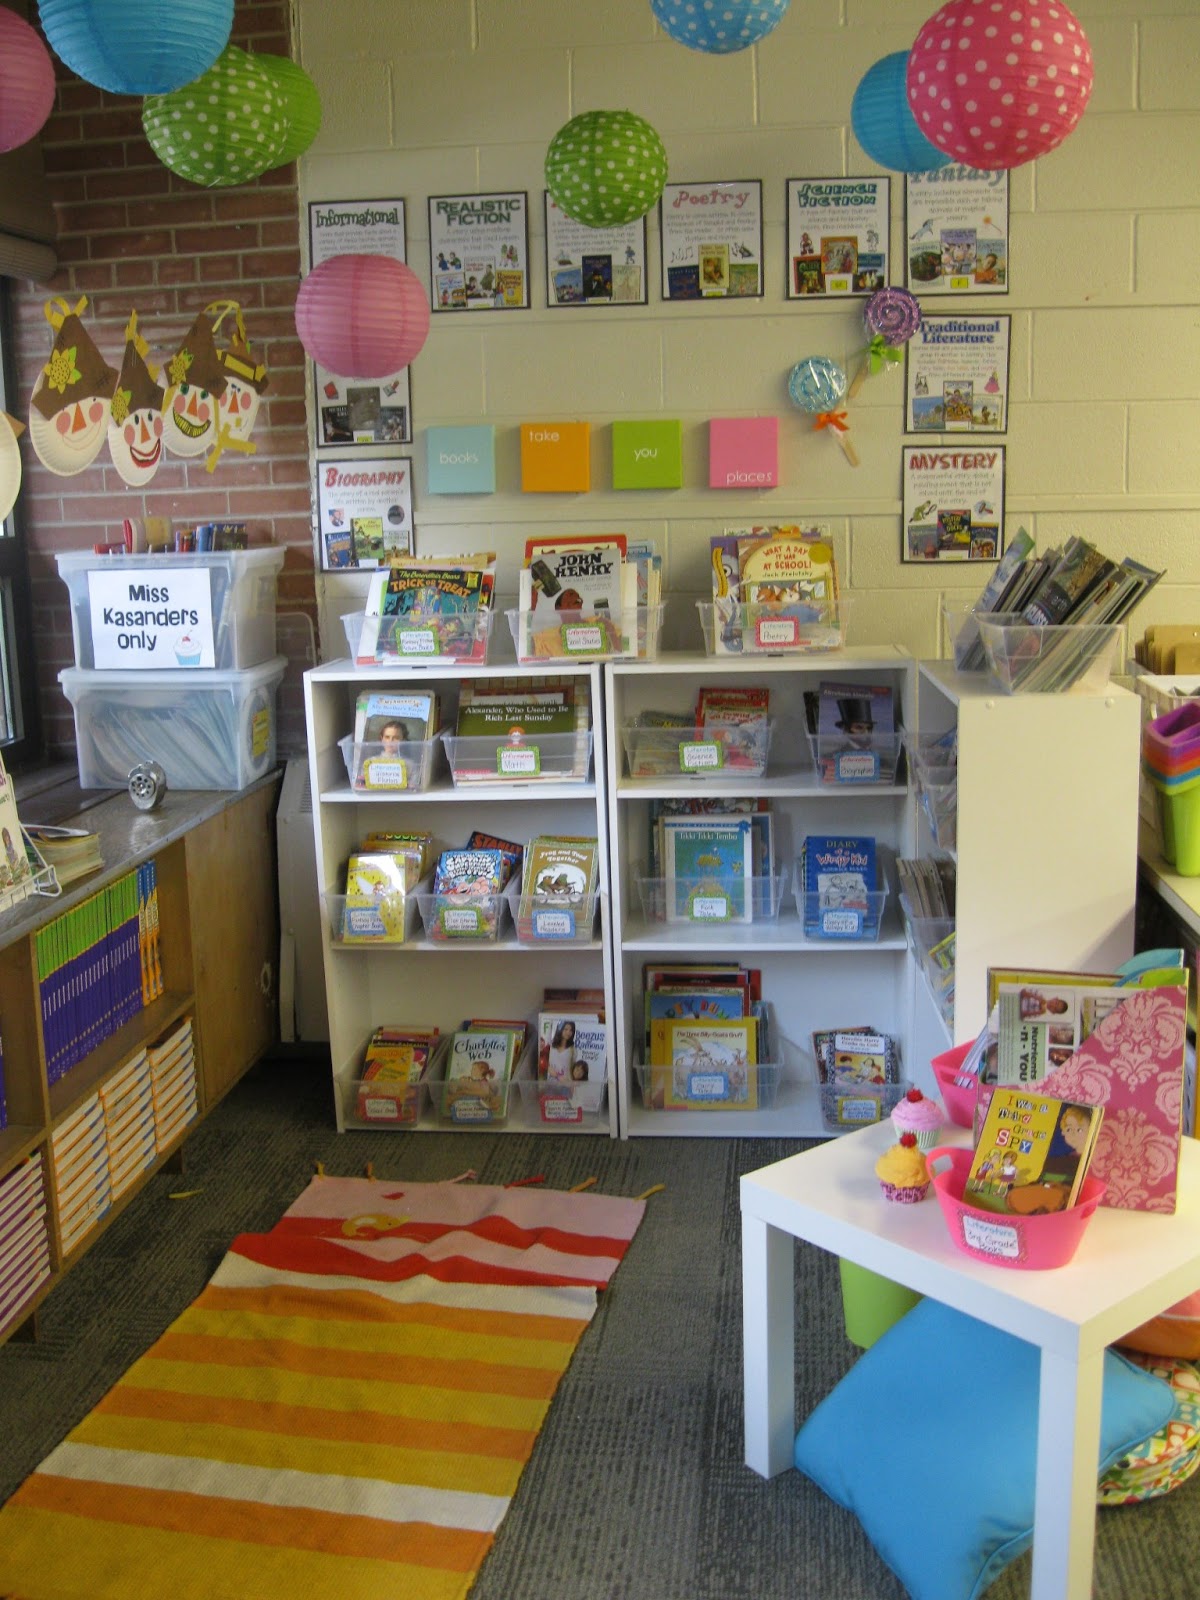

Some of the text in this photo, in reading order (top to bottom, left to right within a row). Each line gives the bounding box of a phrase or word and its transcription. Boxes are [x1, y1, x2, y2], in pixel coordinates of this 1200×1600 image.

[799, 183, 878, 196] SCIENCE
[672, 189, 751, 209] Poetry
[798, 192, 876, 208] FICTION
[436, 199, 521, 215] REALISTIC
[315, 208, 400, 228] Informational
[447, 212, 511, 226] FICTION
[920, 320, 1000, 333] Traditional
[922, 333, 995, 344] Literature
[529, 430, 560, 442] take
[439, 452, 479, 465] books
[634, 447, 658, 461] you
[909, 452, 998, 470] MYSTERY
[325, 467, 405, 488] BIOGRAPHY
[726, 470, 772, 486] places
[763, 545, 808, 557] WHAT A DAY
[558, 552, 602, 568] JOHN
[763, 562, 812, 571] AT SCHOOL!
[554, 562, 613, 578] HENRY
[128, 584, 170, 603] Miss
[391, 578, 425, 593] TRICK
[437, 580, 472, 598] TREAT
[103, 607, 199, 627] Kasanders
[763, 630, 789, 641] Poetry
[465, 706, 503, 714] Alexander,
[826, 840, 858, 848] DIARY
[540, 850, 556, 859] Frog
[816, 854, 868, 867] Wimpy Kid
[575, 1030, 605, 1041] Beezus
[455, 1038, 507, 1054] Charlotte's
[1030, 1026, 1039, 1080] Nutrients
[1007, 1096, 1014, 1106] I
[995, 1128, 1033, 1154] SPY
[966, 1219, 1015, 1237] Literature
